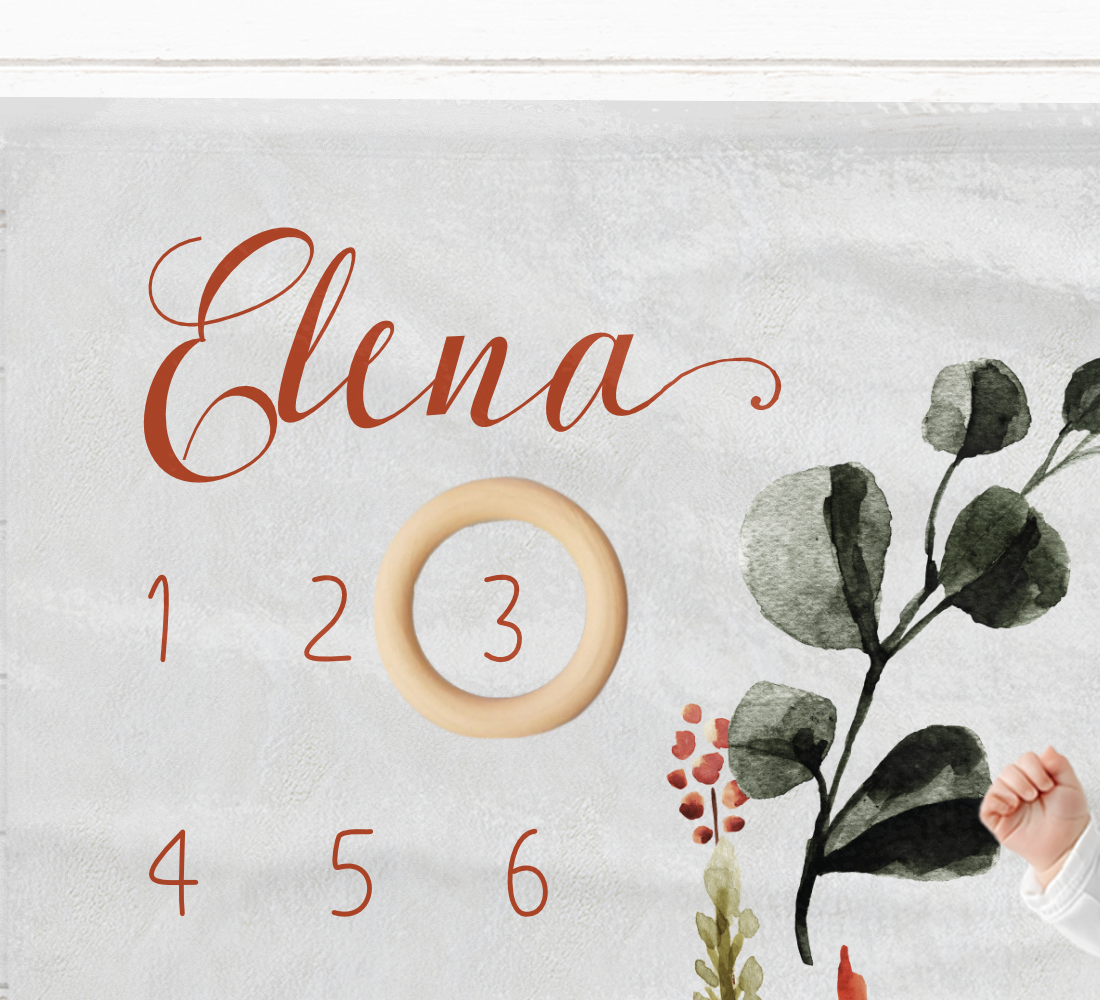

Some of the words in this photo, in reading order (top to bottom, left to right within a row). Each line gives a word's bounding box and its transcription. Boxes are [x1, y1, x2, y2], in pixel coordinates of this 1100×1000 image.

[143, 226, 782, 484] Elena
[147, 574, 170, 663] 1
[303, 574, 352, 663] 2
[483, 574, 523, 663] 3
[148, 829, 199, 917] 4
[331, 828, 374, 917] 5
[507, 828, 549, 917] 6
